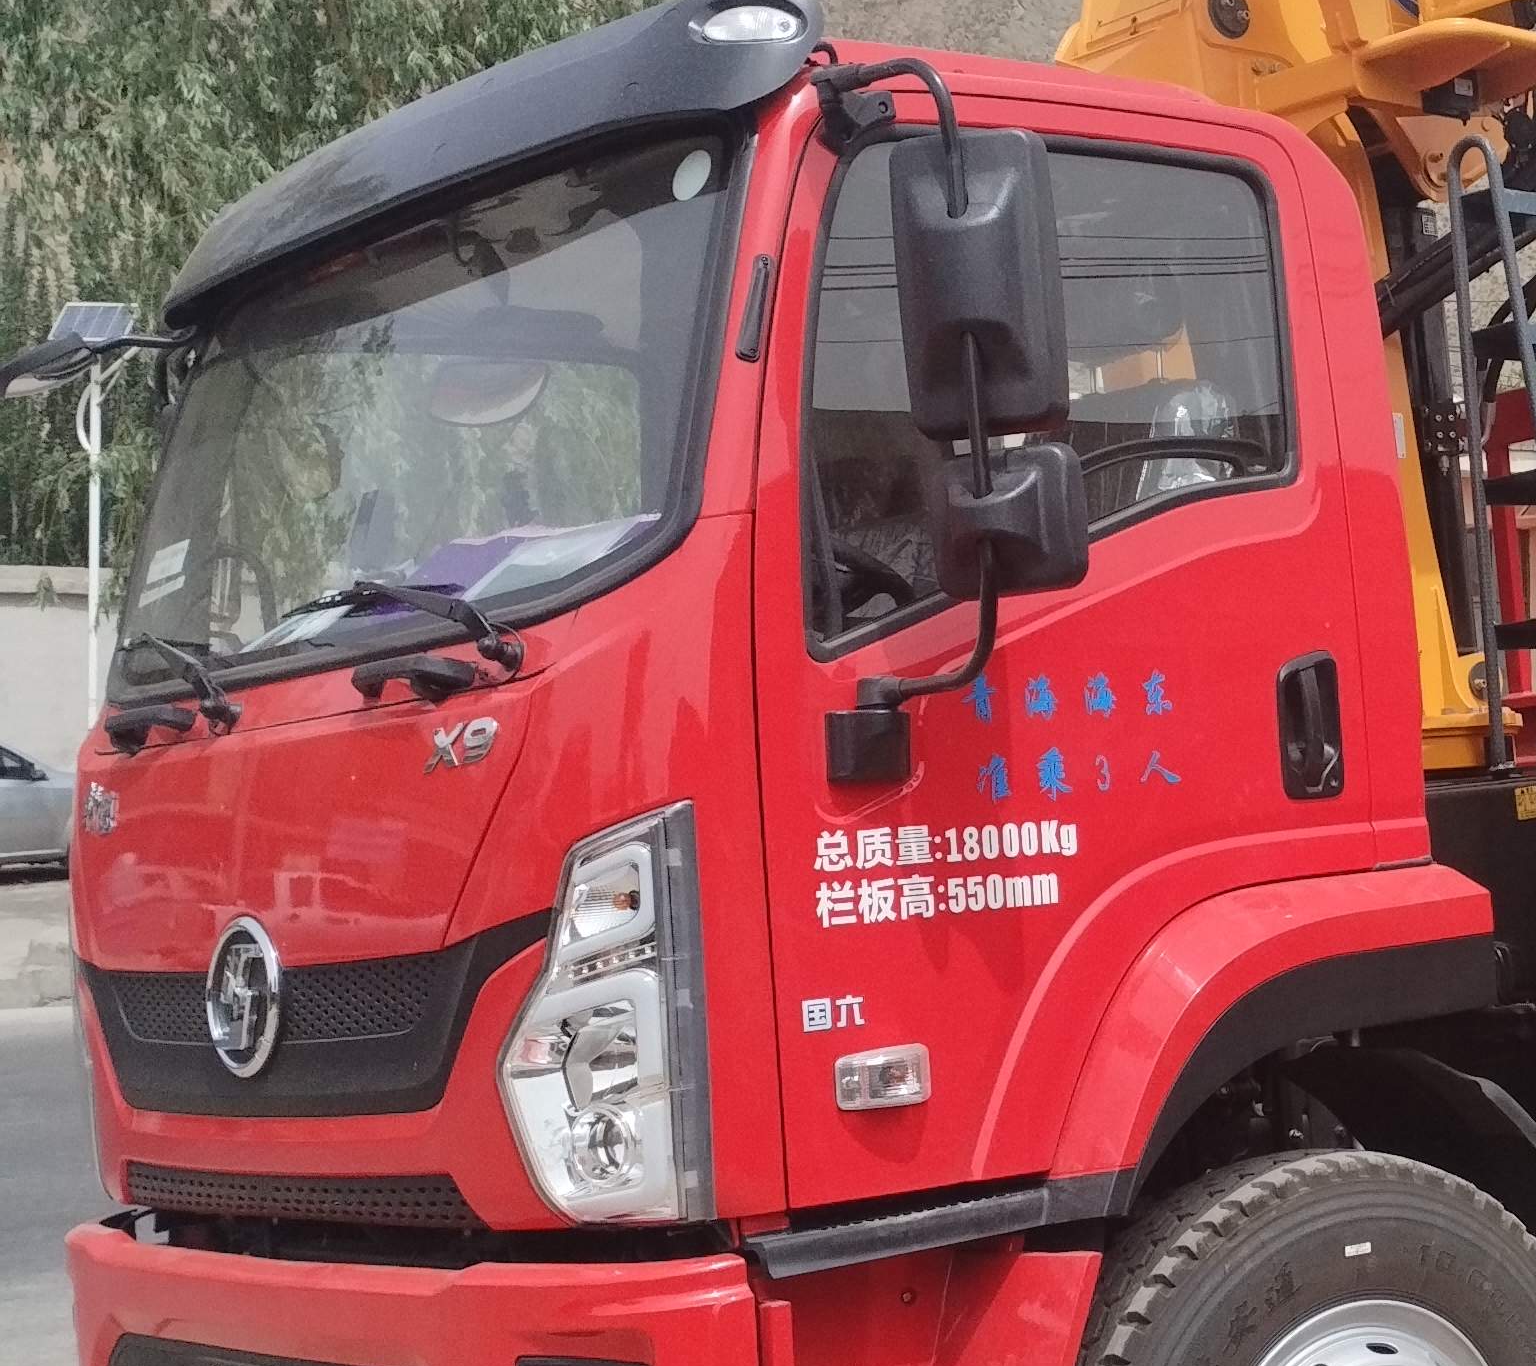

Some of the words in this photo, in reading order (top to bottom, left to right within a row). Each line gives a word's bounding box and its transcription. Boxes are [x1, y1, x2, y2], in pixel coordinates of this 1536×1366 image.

[961, 668, 1173, 724] 青海海东
[423, 716, 500, 776] X9
[976, 746, 1183, 804] 准乘3人
[801, 994, 866, 1033] 国六
